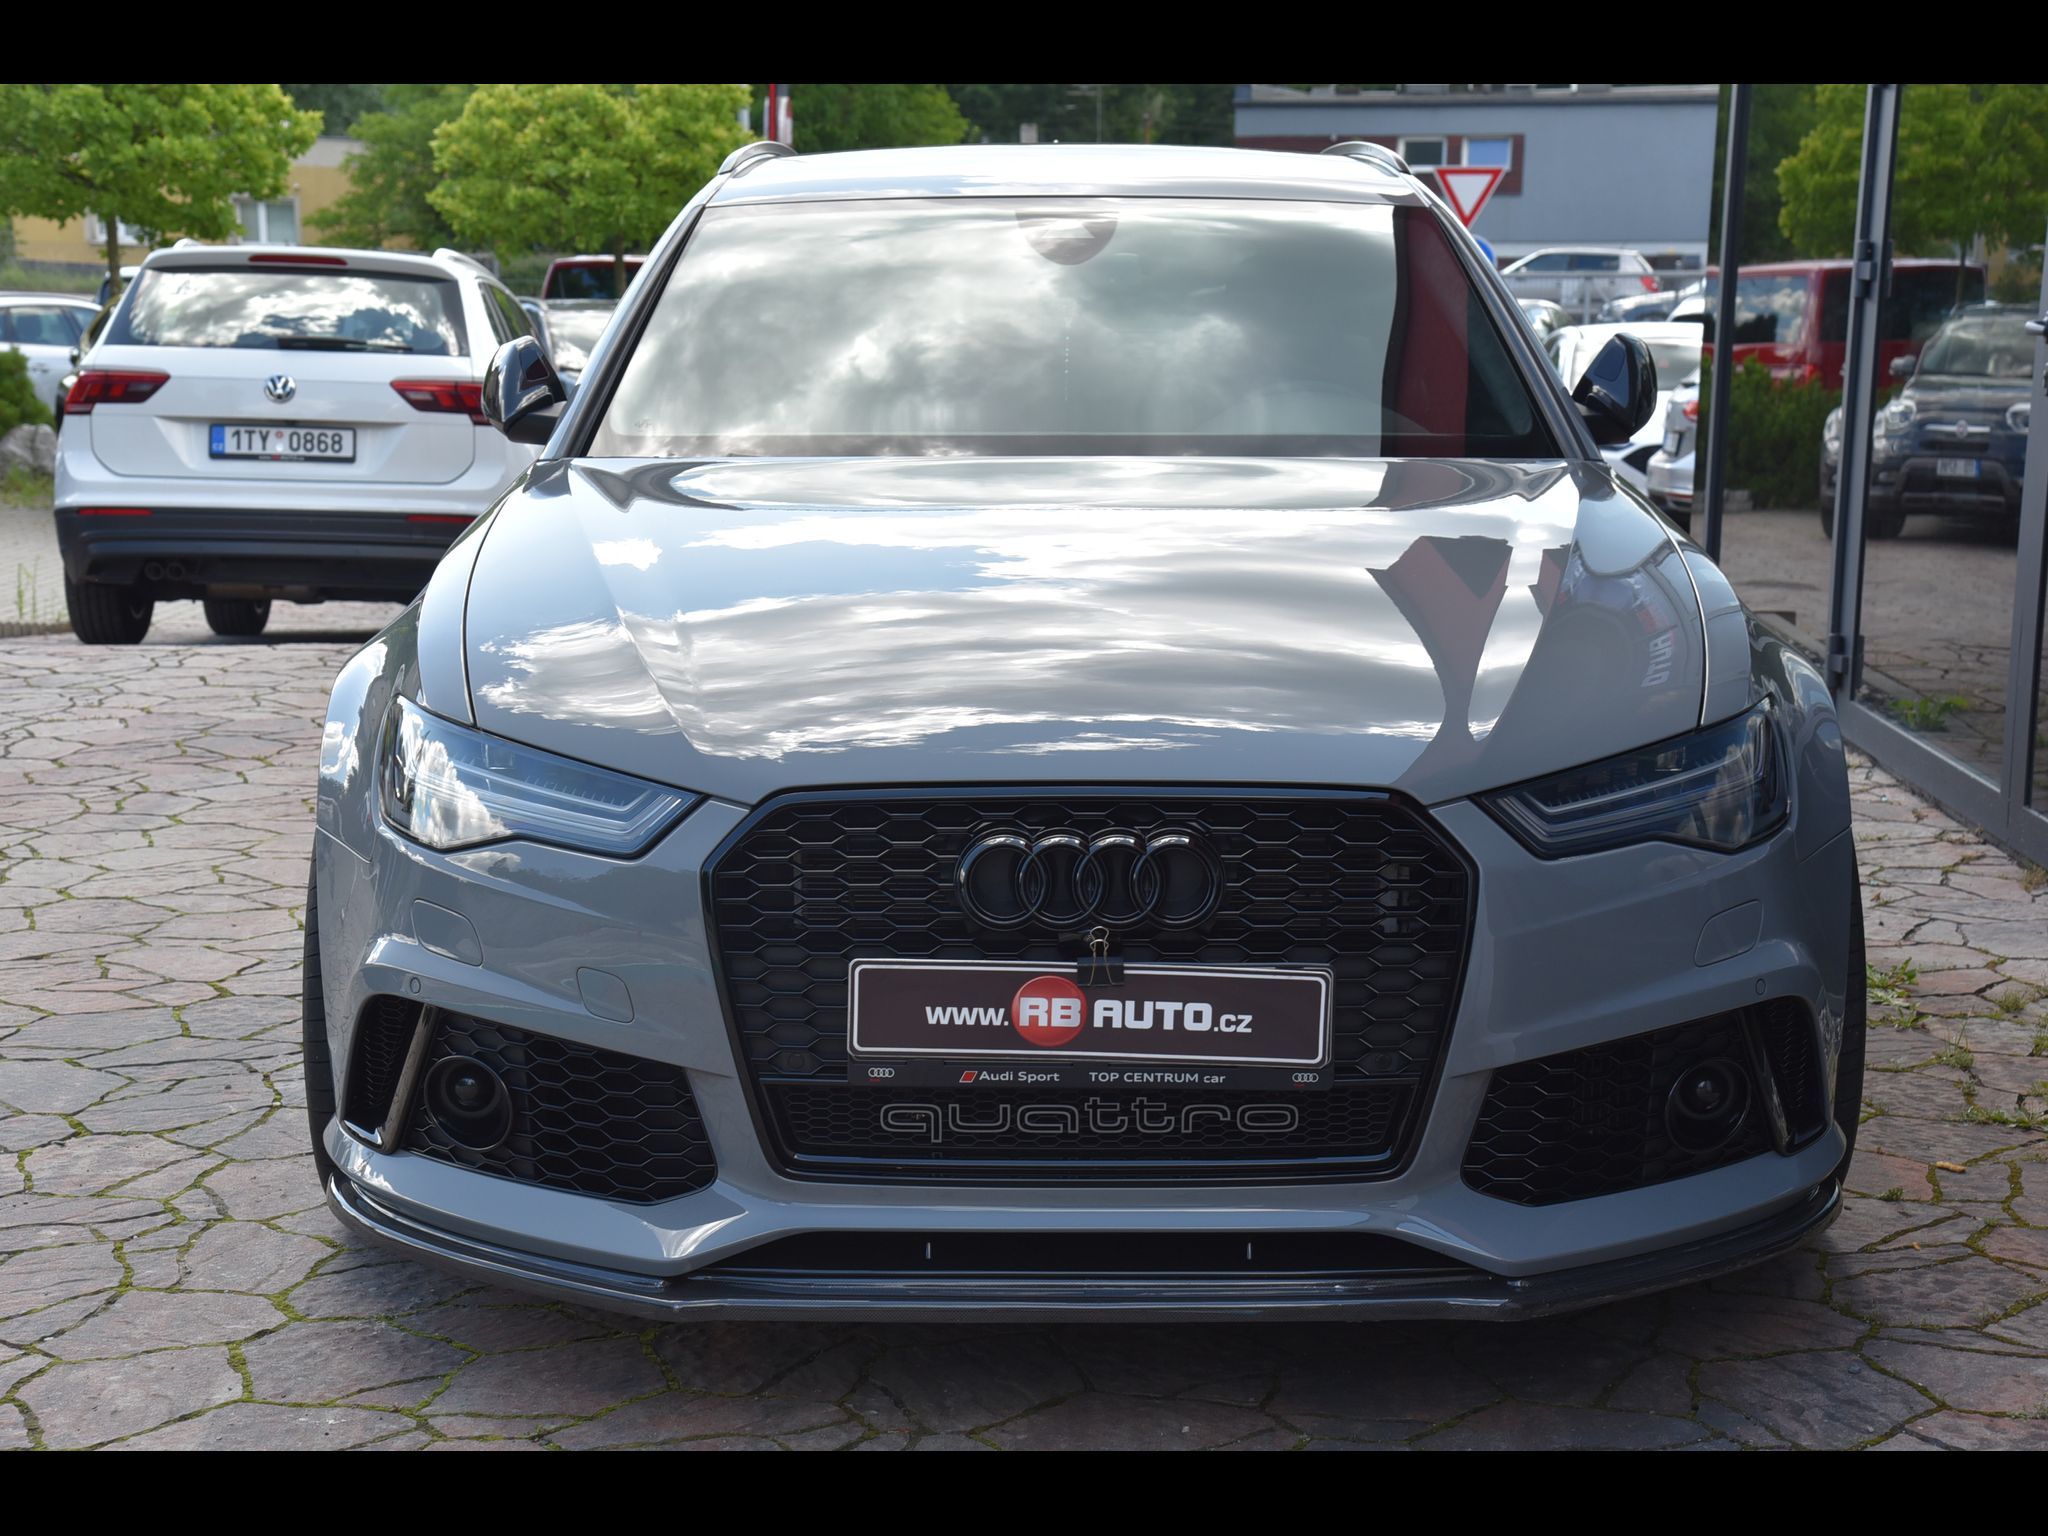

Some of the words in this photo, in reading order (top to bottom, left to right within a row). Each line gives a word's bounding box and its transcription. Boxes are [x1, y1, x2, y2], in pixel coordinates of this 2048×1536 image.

[231, 430, 270, 451] 1TY
[288, 431, 343, 453] 0868
[978, 1070, 1014, 1082] Audi
[1017, 1071, 1061, 1084] Sport
[1089, 1072, 1119, 1083] TOP
[1123, 1072, 1199, 1083] CENTRUM
[1203, 1075, 1226, 1084] car
[880, 1097, 1299, 1144] quattro
